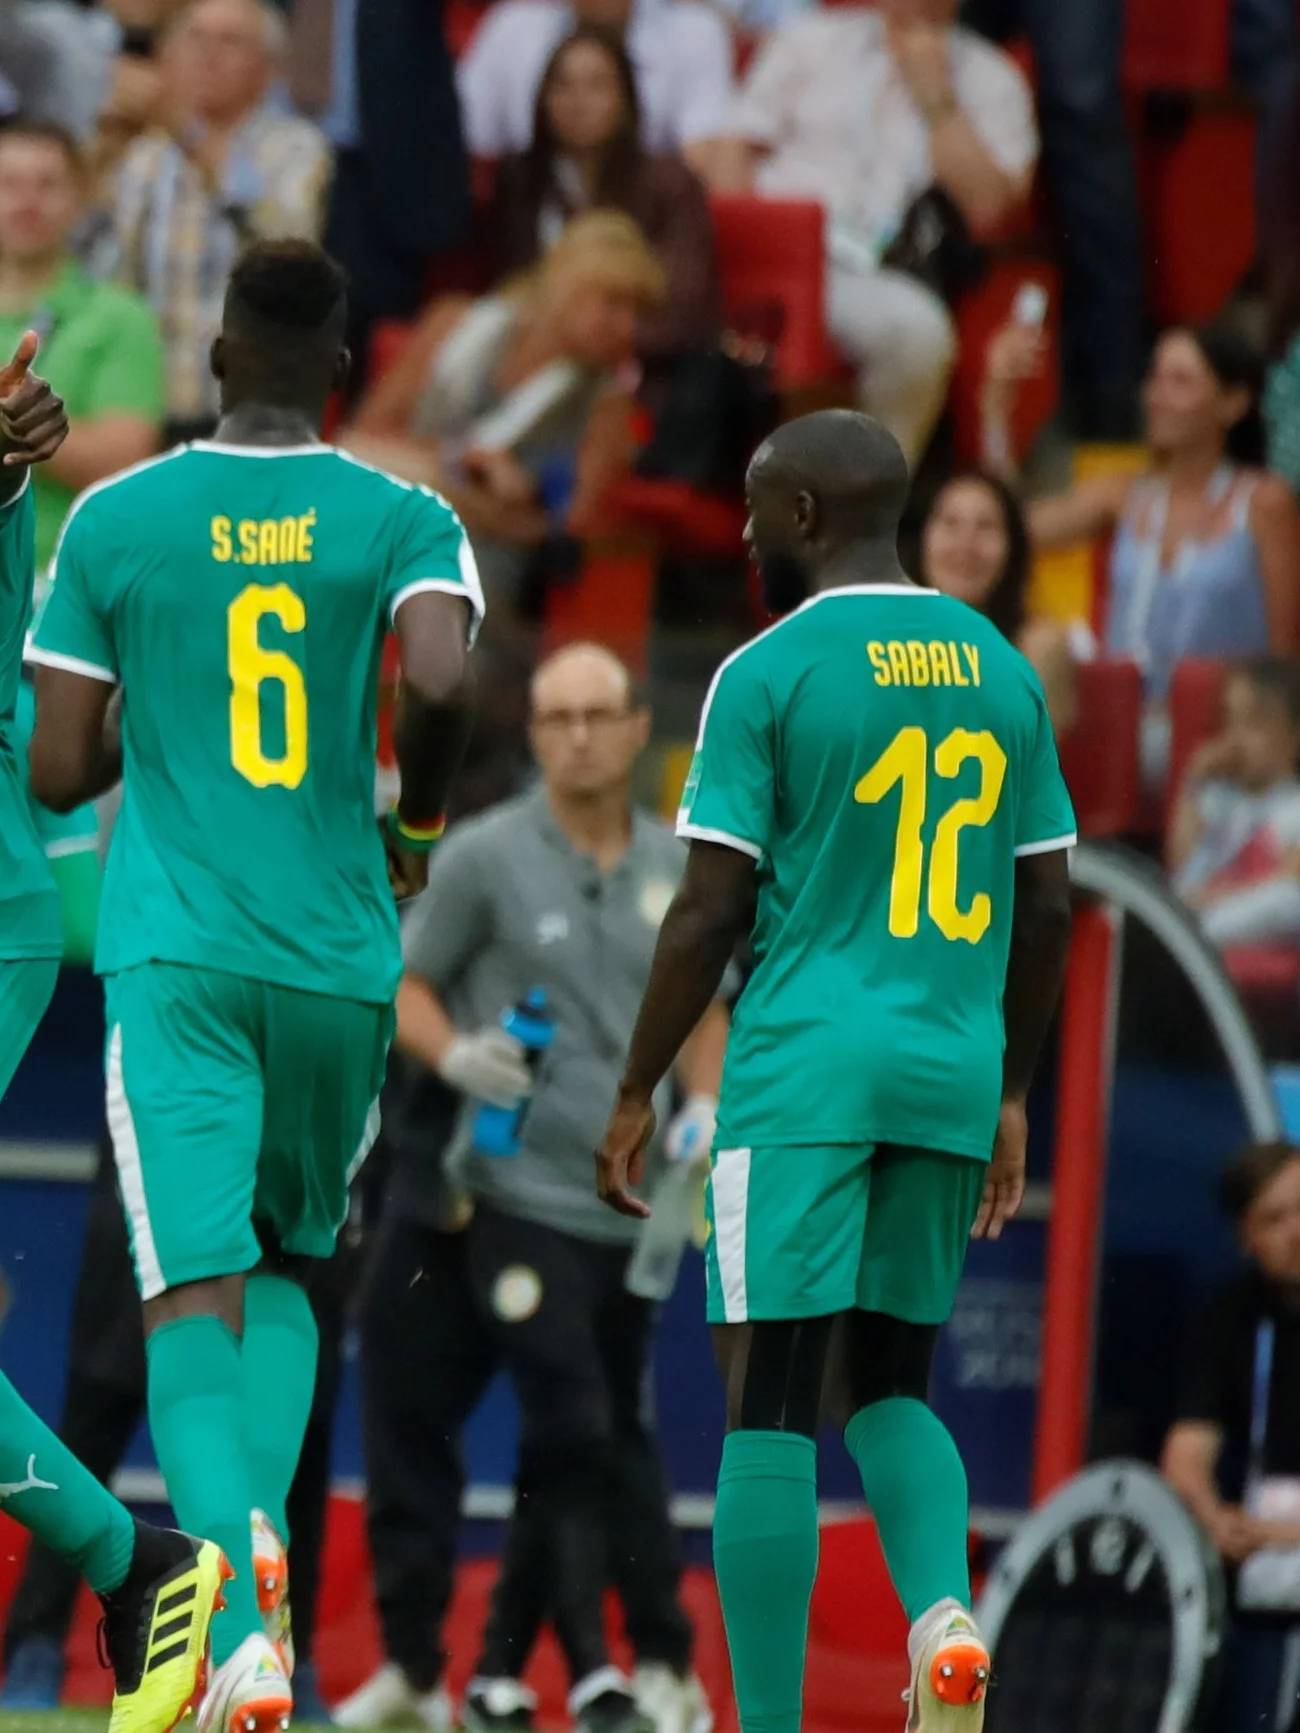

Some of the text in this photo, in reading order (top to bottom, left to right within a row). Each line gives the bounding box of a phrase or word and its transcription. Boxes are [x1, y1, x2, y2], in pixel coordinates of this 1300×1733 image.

[227, 582, 309, 790] 6
[866, 639, 982, 688] SABALY
[853, 725, 1009, 945] 12
